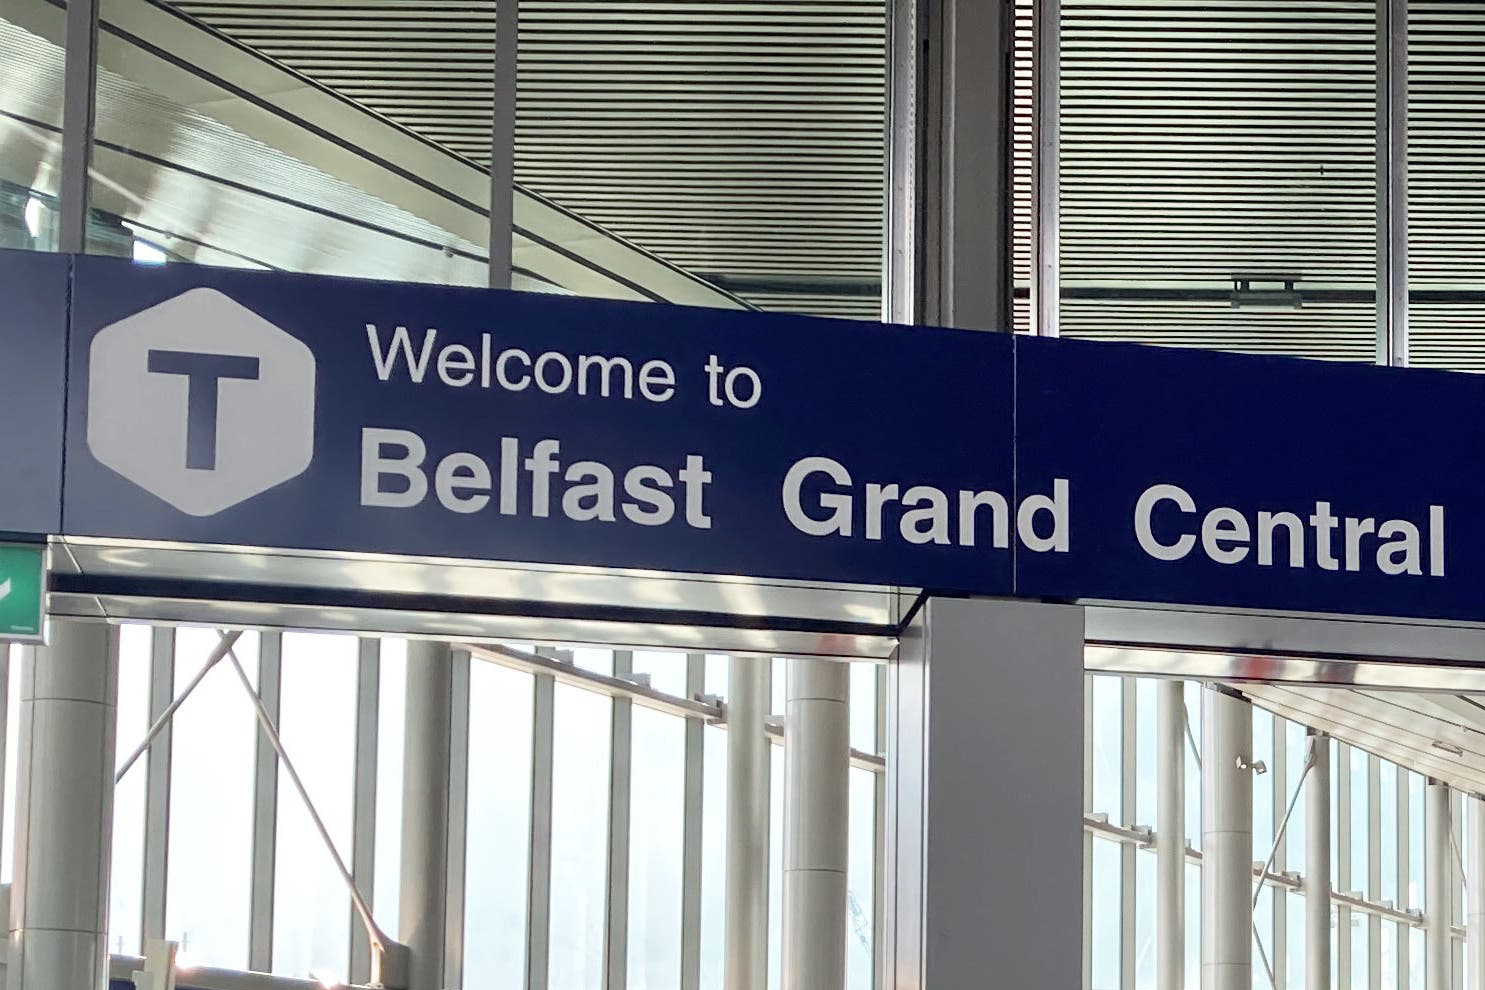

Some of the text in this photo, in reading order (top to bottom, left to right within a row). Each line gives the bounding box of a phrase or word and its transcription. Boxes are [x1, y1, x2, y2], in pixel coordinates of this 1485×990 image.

[147, 349, 260, 471] T
[365, 323, 762, 409] Welcome to
[360, 427, 712, 529] Belfast
[782, 456, 1070, 554] Grand
[1134, 484, 1445, 577] Central
